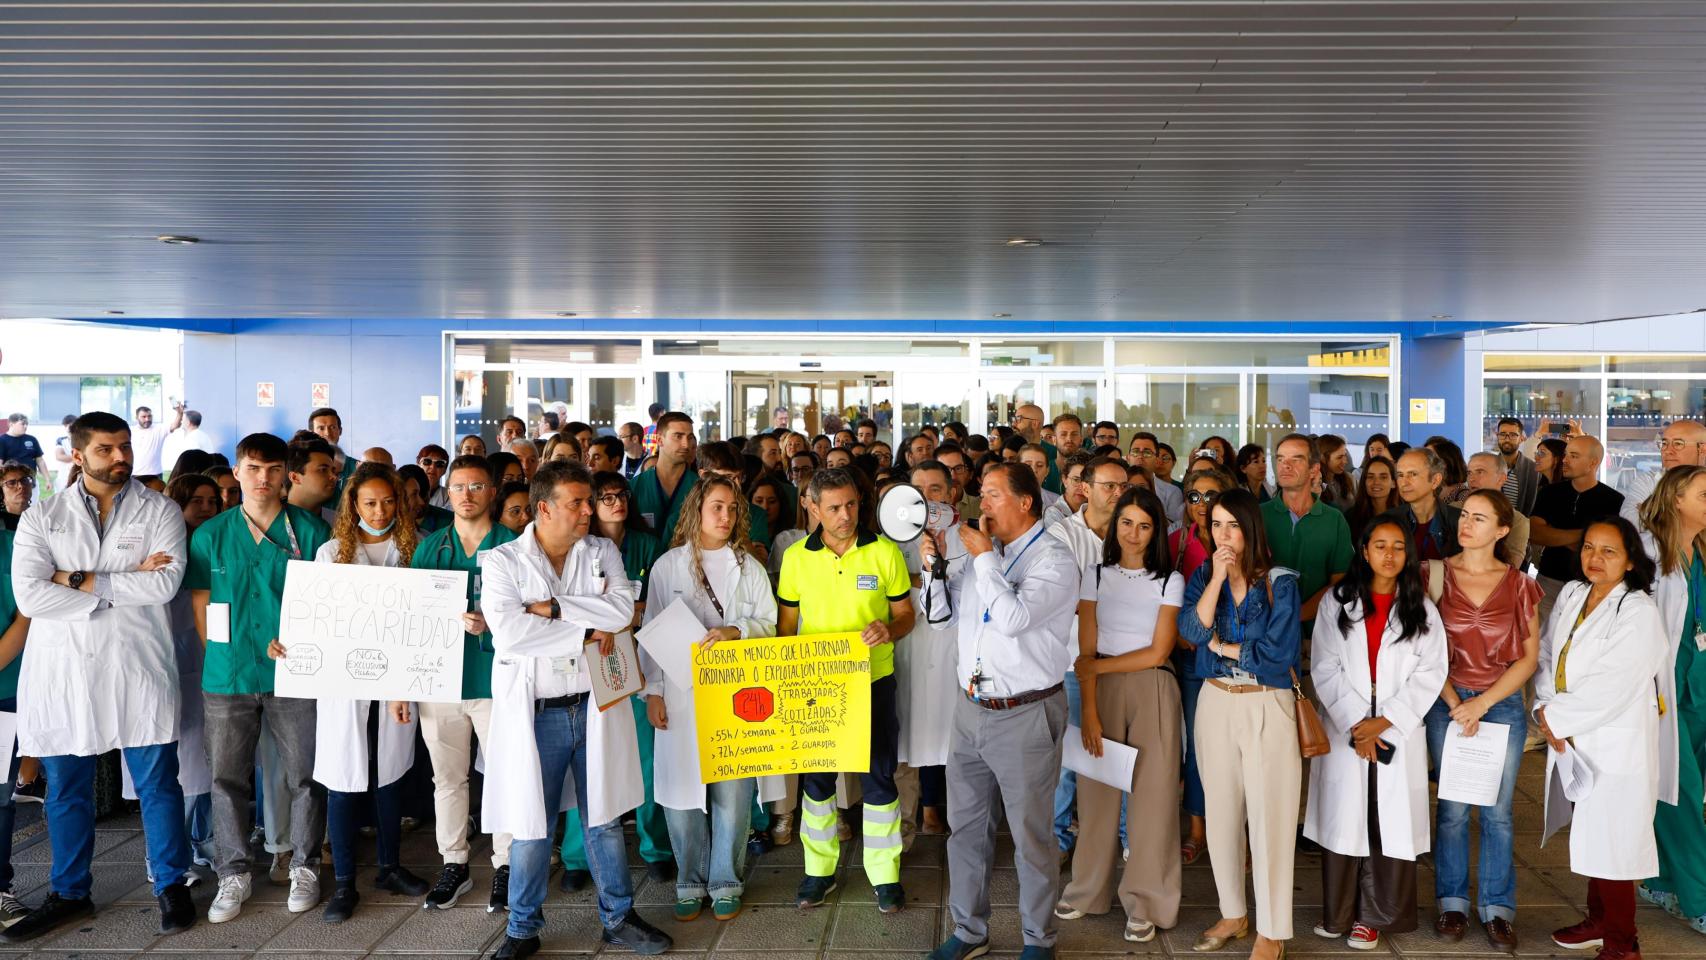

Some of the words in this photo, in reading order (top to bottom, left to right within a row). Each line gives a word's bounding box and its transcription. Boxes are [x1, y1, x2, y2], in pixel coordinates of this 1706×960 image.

[296, 574, 413, 611] VOCACIÓN
[288, 600, 460, 649] PRECARIEDAD
[355, 650, 373, 660] NO
[744, 645, 777, 661] MENOS
[780, 644, 798, 661] QUE
[800, 641, 810, 657] LA
[812, 639, 851, 659] JORNADA
[699, 667, 746, 685] ORDINARIA
[753, 666, 760, 683] O
[764, 662, 817, 682] EXPLOTACIÓN
[783, 687, 839, 700] TRABAJADAS
[743, 692, 767, 717] 24h
[784, 704, 837, 721] COTIZADAS
[789, 725, 796, 737] 1
[799, 725, 830, 735] GUARDIA
[791, 740, 799, 751] 2
[802, 740, 836, 749] GUARDIAS
[791, 759, 798, 770] 3
[802, 759, 837, 768] GUARDIAS
